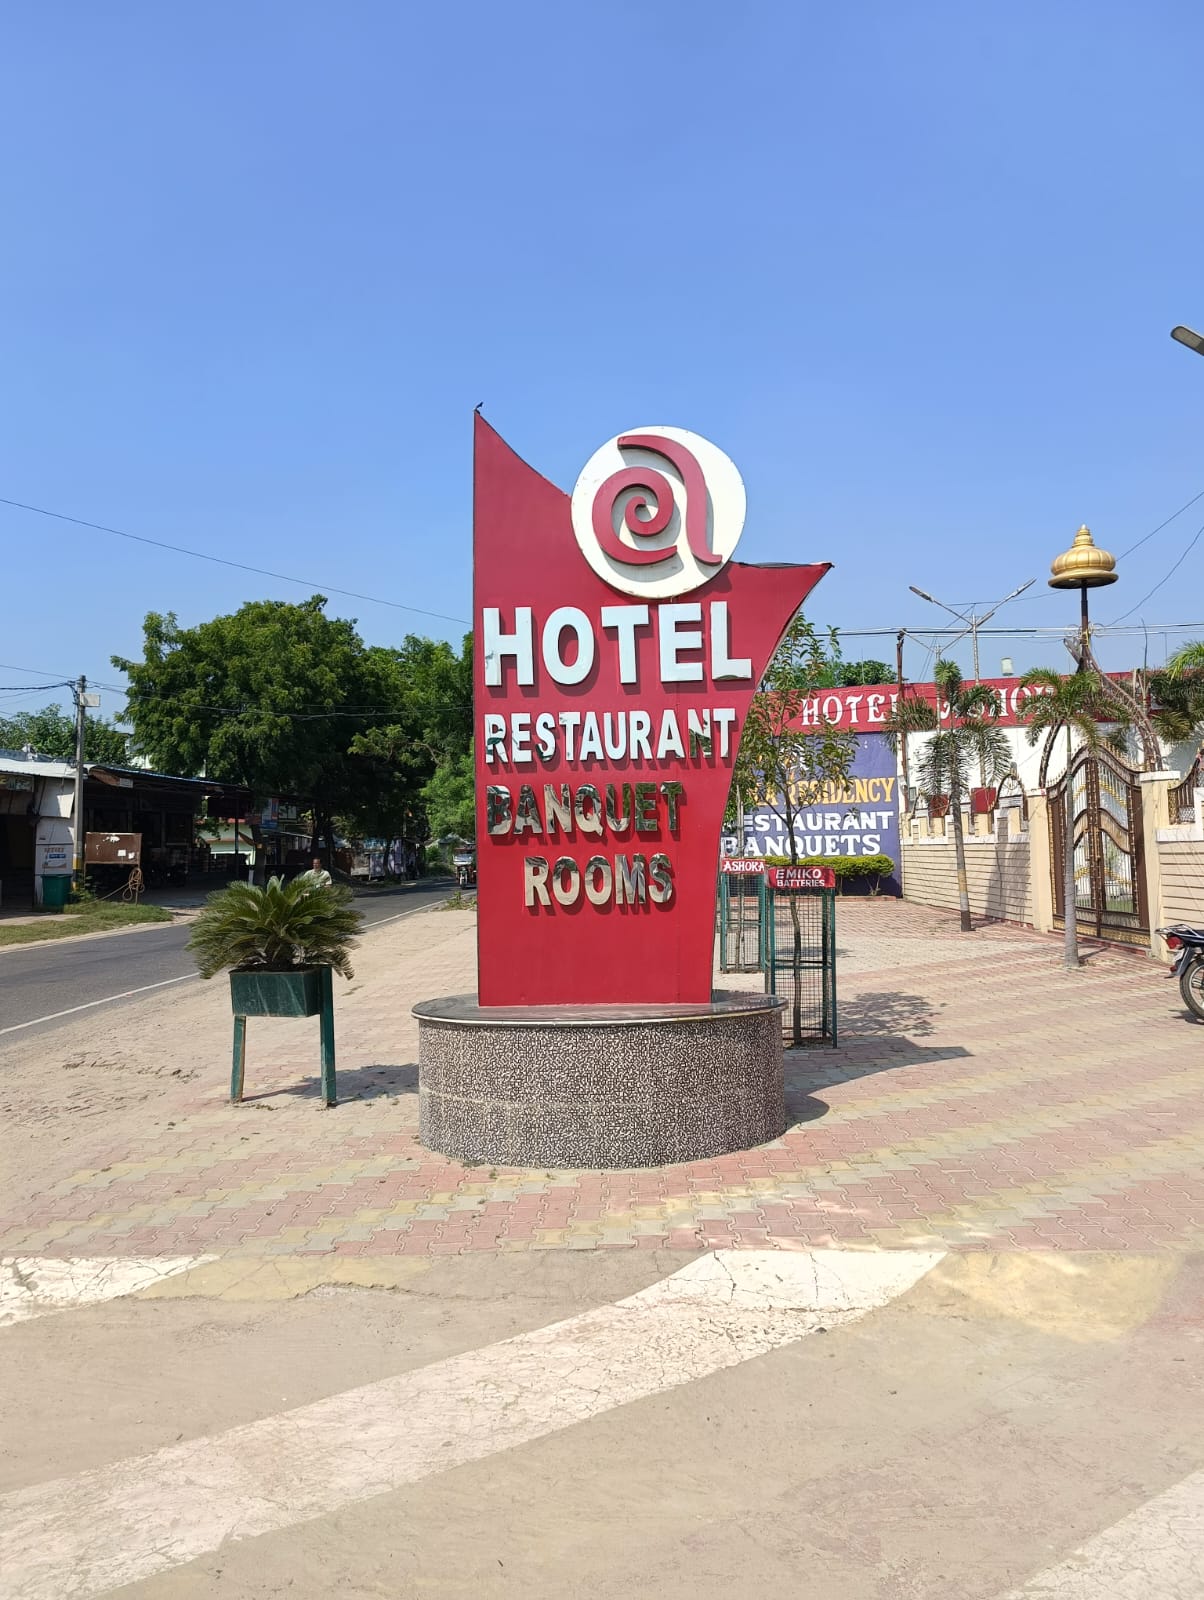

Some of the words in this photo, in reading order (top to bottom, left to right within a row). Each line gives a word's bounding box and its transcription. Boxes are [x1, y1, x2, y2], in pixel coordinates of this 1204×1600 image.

[482, 601, 753, 687] HOTEL
[484, 708, 737, 765] RESTAURANT
[485, 780, 687, 837] BANQUET
[719, 833, 881, 859] BANQUETS
[723, 860, 765, 872] ASHOKA
[523, 852, 675, 907] ROOMS
[775, 868, 822, 879] EMIKO
[776, 879, 826, 888] BATTERIES
